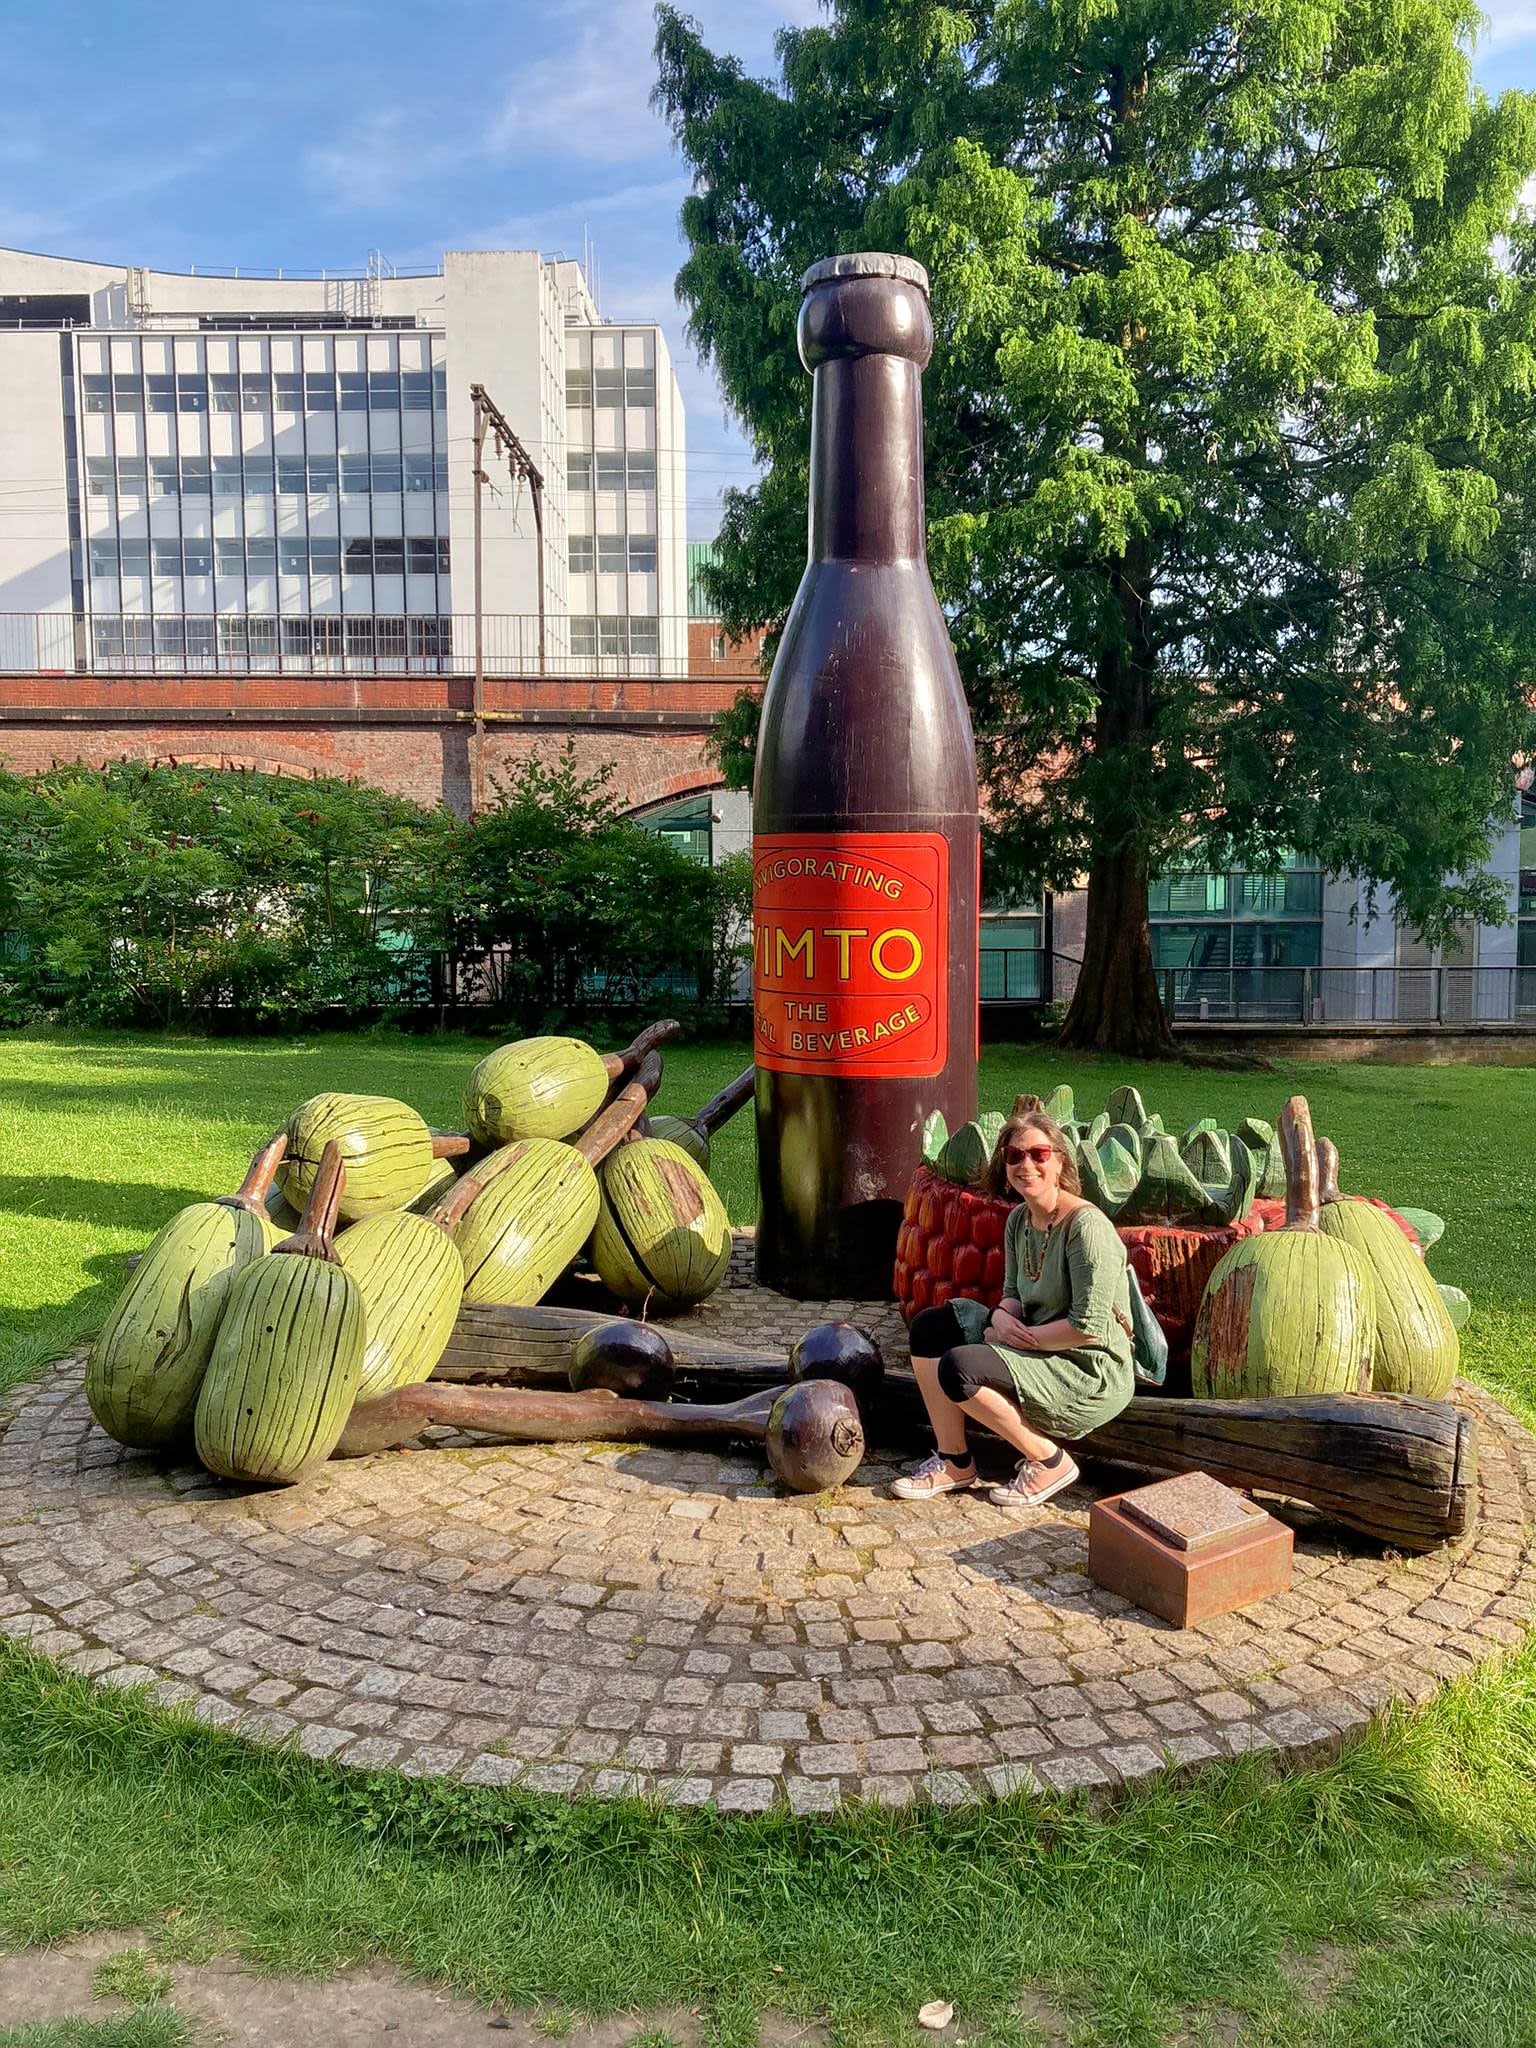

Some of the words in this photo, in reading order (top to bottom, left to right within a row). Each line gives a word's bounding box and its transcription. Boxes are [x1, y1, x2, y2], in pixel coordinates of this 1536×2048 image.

[753, 858, 904, 900] NVIGORATING
[754, 927, 922, 981] VIMTO
[754, 1010, 776, 1043] EAL
[791, 1003, 921, 1052] BEVERAGE
[784, 1001, 827, 1021] THE
